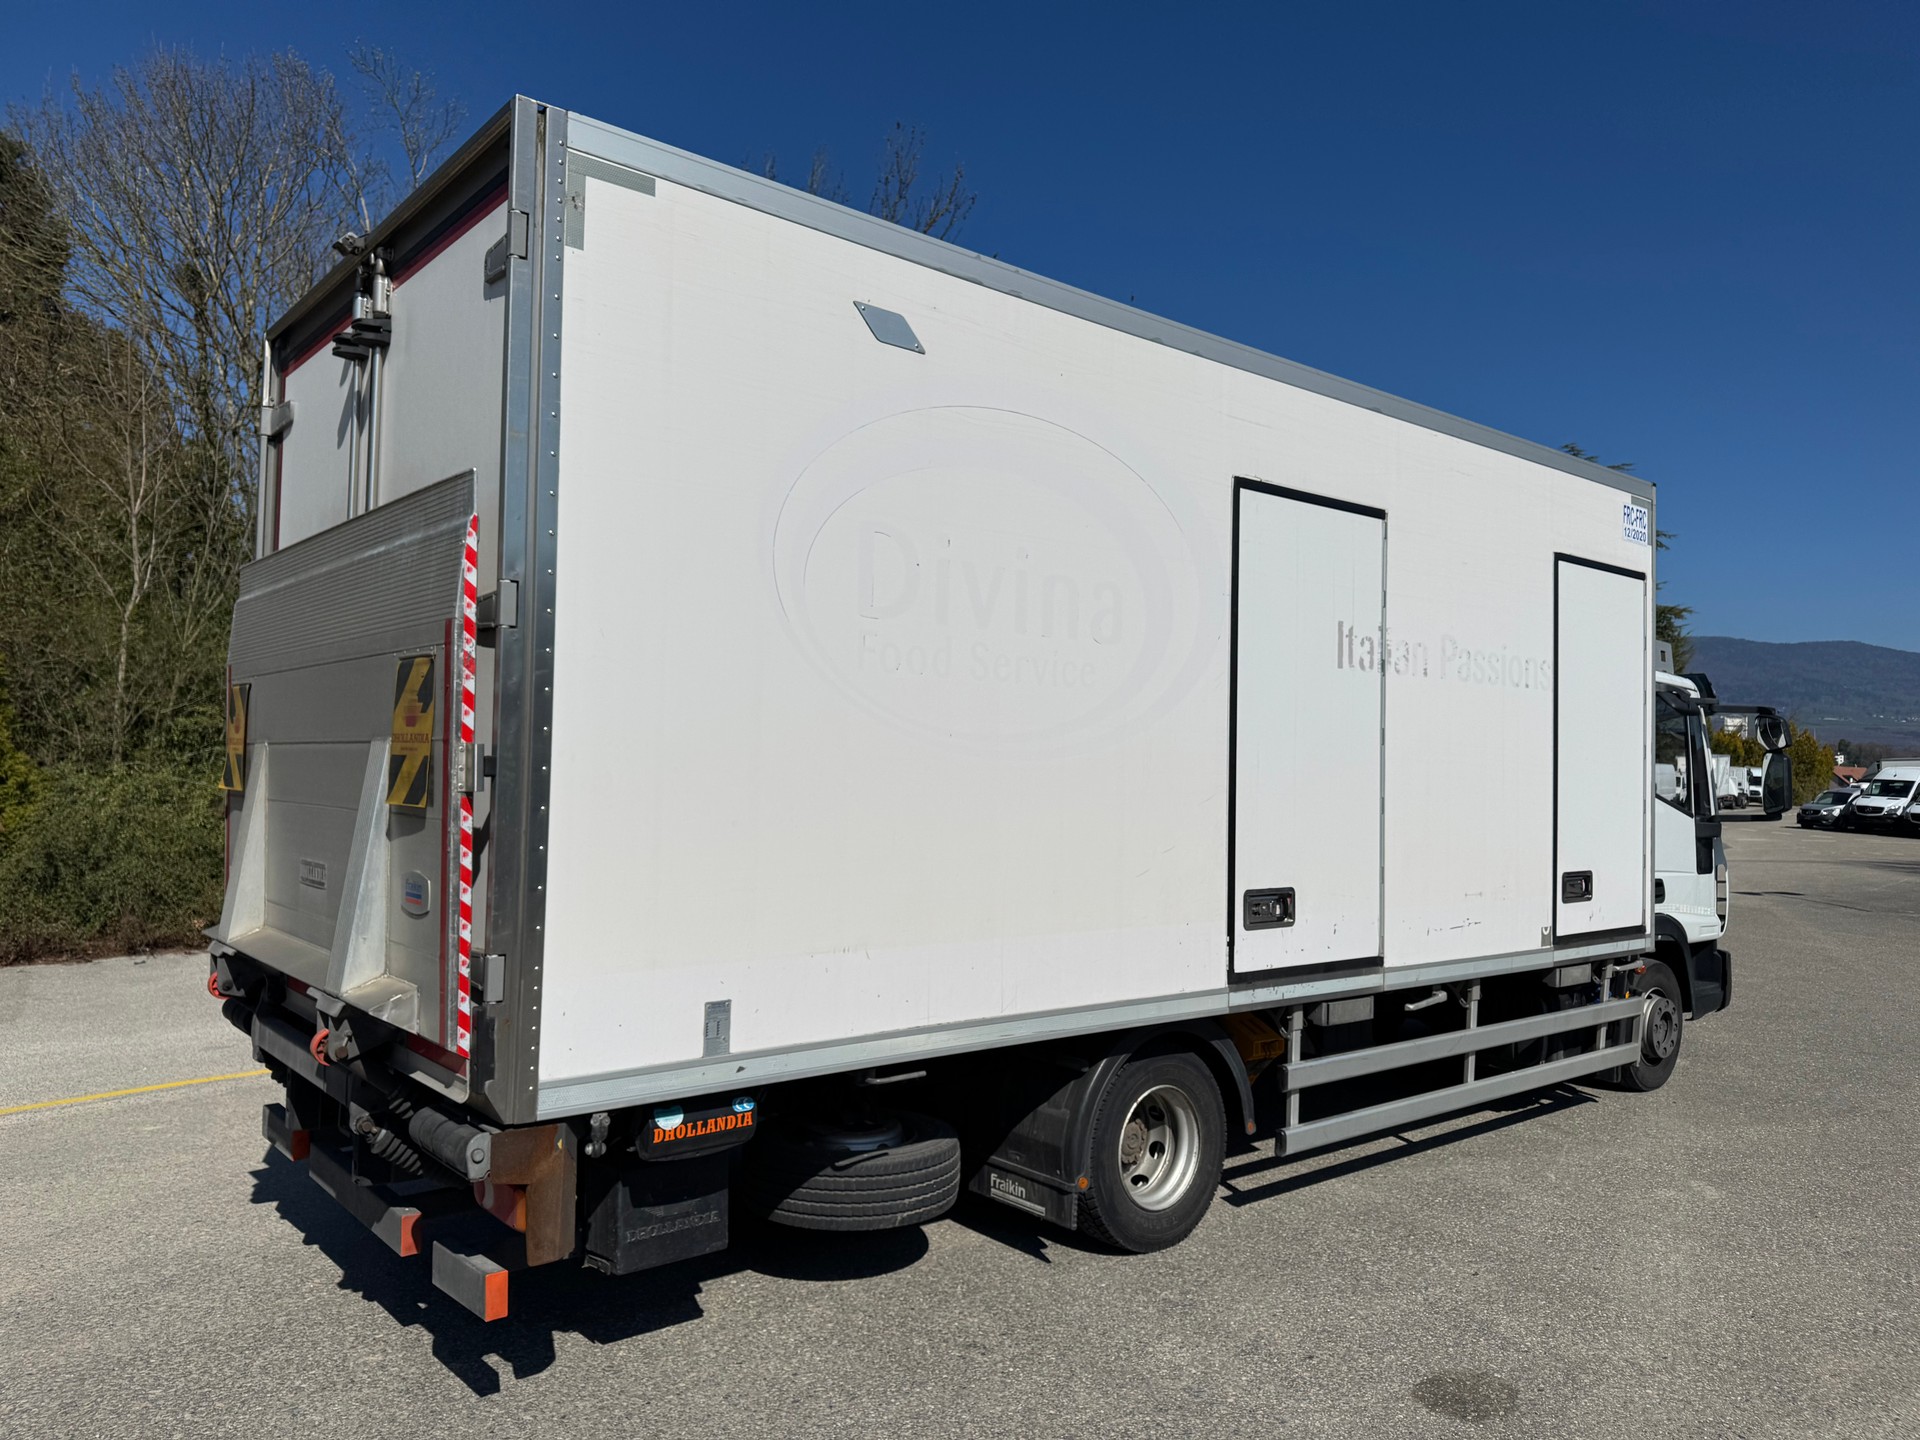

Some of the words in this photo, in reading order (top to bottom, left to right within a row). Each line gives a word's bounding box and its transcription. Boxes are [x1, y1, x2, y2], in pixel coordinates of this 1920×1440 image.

[1623, 504, 1647, 530] FRC-FRC
[856, 519, 1126, 646] Divina
[858, 630, 953, 679] Food
[969, 640, 1097, 688] Service
[1440, 633, 1552, 692] Passions
[653, 1111, 753, 1144] DHOLLANDIA
[990, 1172, 1026, 1199] Fraikin
